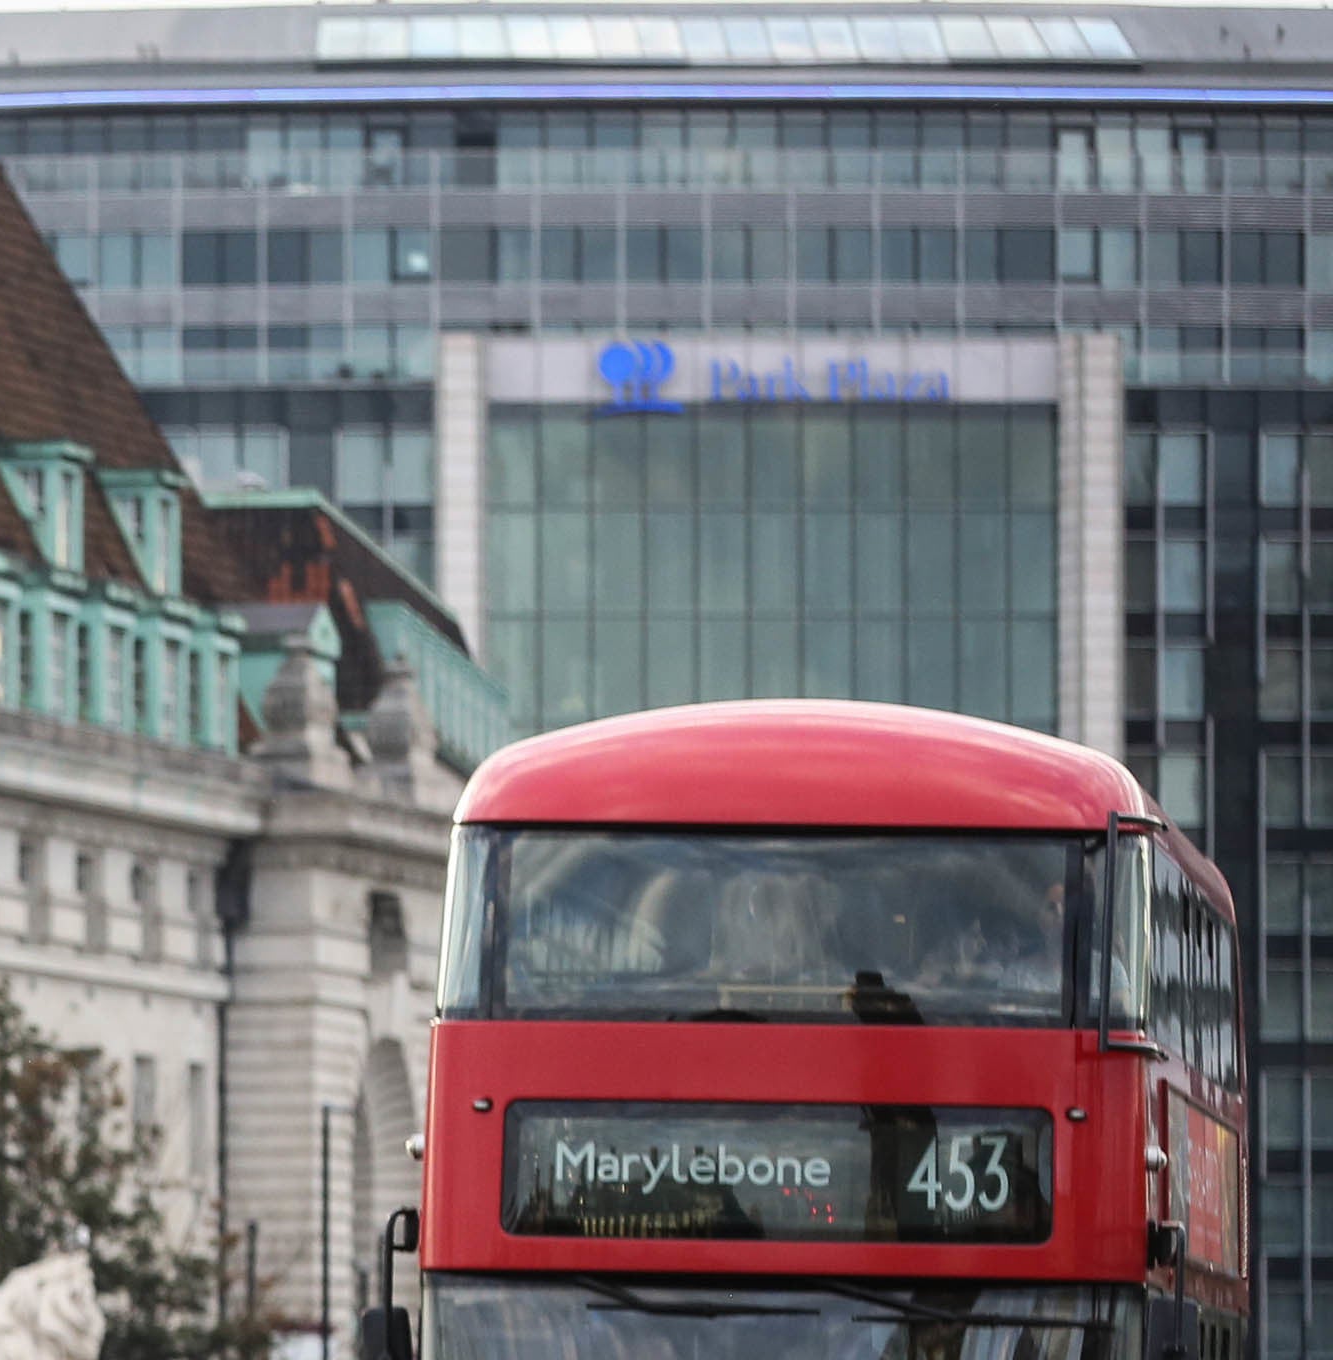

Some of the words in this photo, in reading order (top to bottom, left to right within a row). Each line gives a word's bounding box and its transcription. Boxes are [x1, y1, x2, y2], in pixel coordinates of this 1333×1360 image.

[711, 356, 812, 401] Park
[827, 356, 950, 401] Plaza
[554, 1140, 831, 1194] Marylebone
[907, 1135, 1010, 1211] 453
